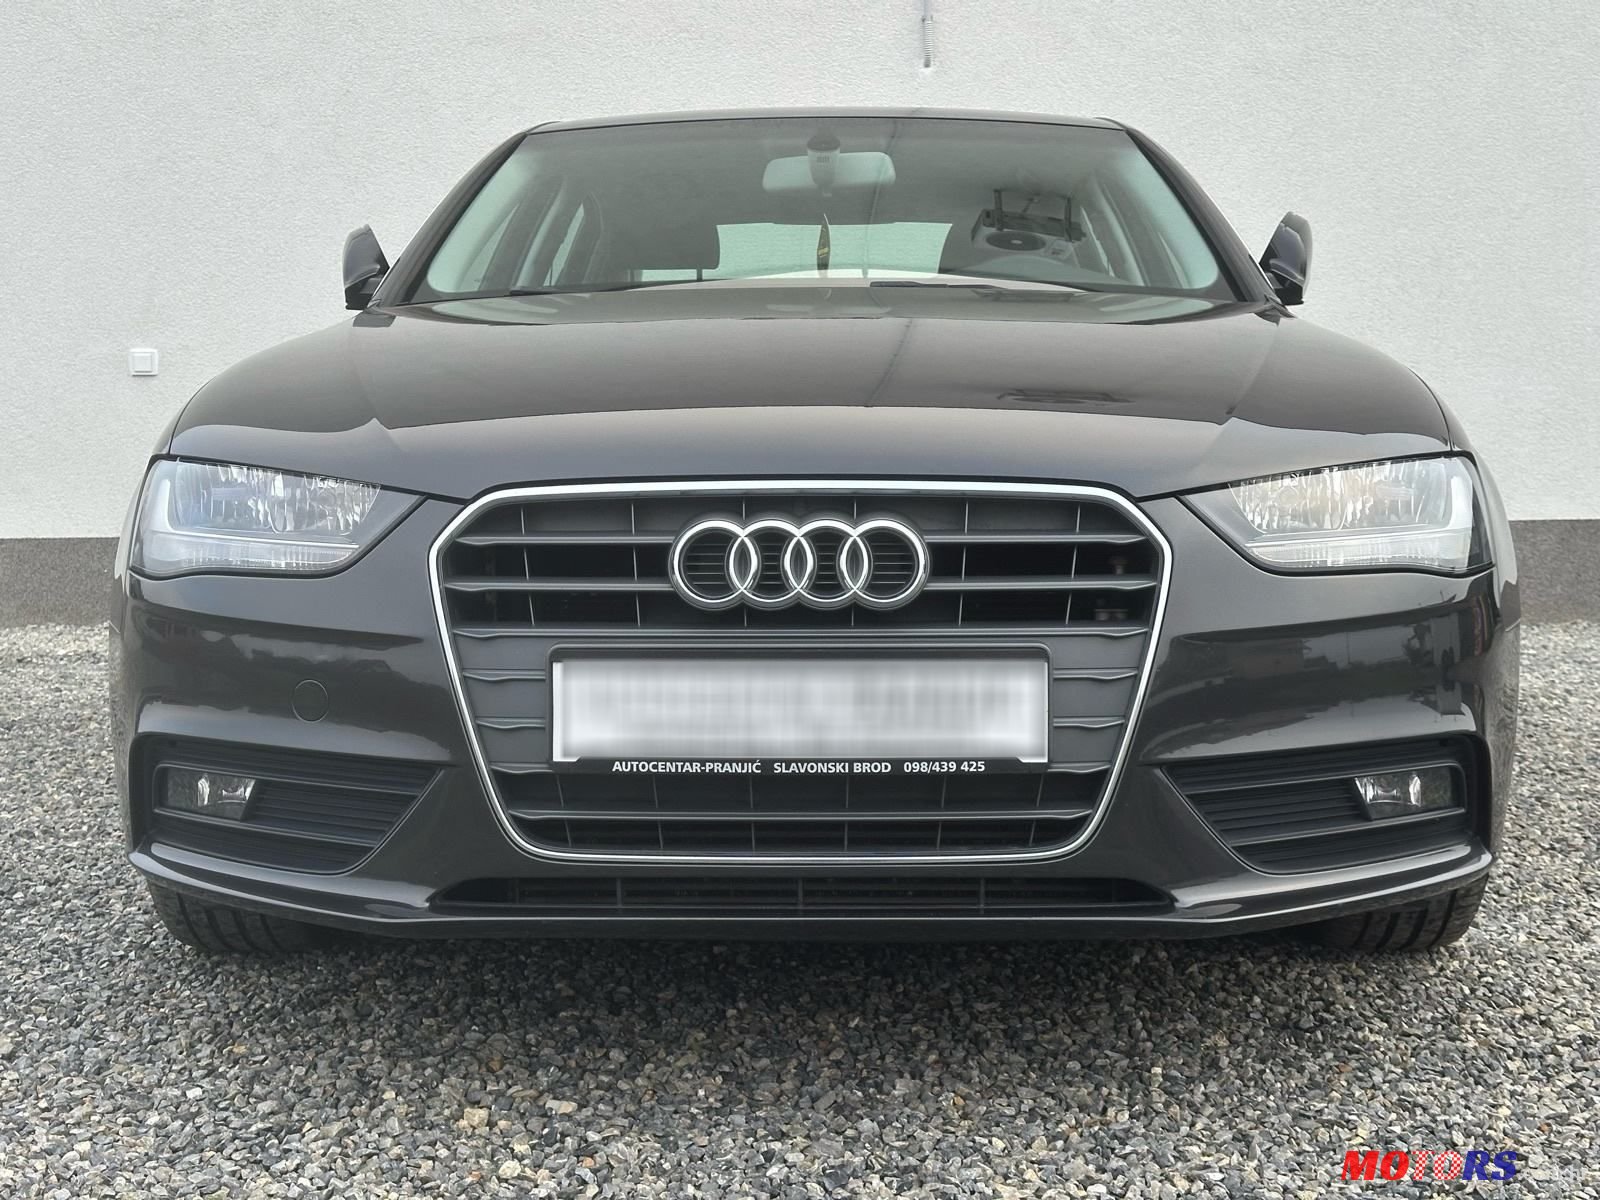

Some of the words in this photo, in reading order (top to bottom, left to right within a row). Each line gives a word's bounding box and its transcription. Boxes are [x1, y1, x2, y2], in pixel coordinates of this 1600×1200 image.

[611, 759, 762, 774] AUTOCENTAR-PRANJIĆ
[773, 762, 849, 774] SLAVONSKI
[853, 761, 892, 773] BROD
[903, 760, 957, 774] 098/439
[960, 760, 986, 773] 425
